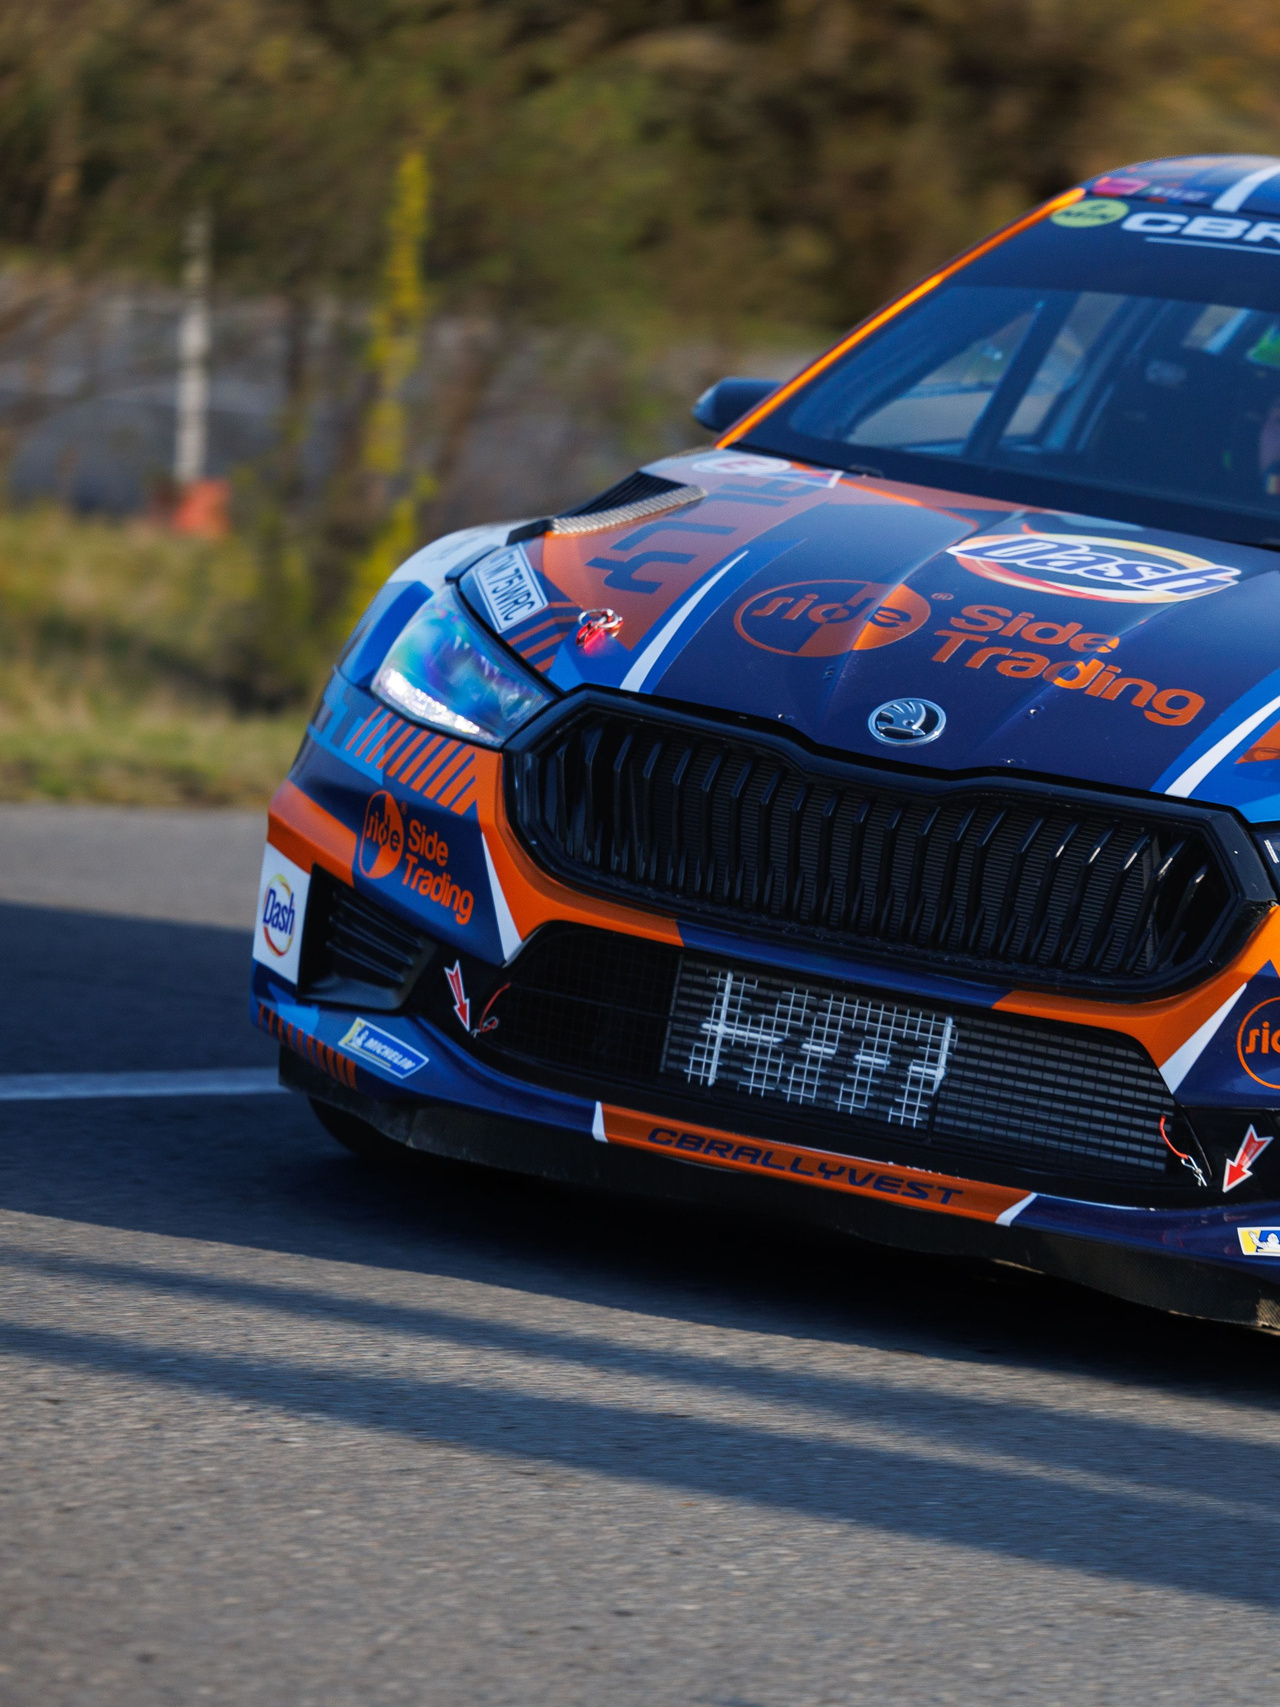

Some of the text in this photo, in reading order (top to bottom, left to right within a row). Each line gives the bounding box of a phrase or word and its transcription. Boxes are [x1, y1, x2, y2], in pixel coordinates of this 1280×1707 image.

[488, 566, 536, 622] 75WRC
[949, 537, 1241, 597] Dash
[948, 604, 1121, 655] Side
[931, 629, 1206, 727] Trading
[407, 818, 449, 868] Side
[262, 887, 296, 936] Dash
[401, 852, 475, 926] Trading
[647, 1126, 965, 1205] CBRALLYVEST
